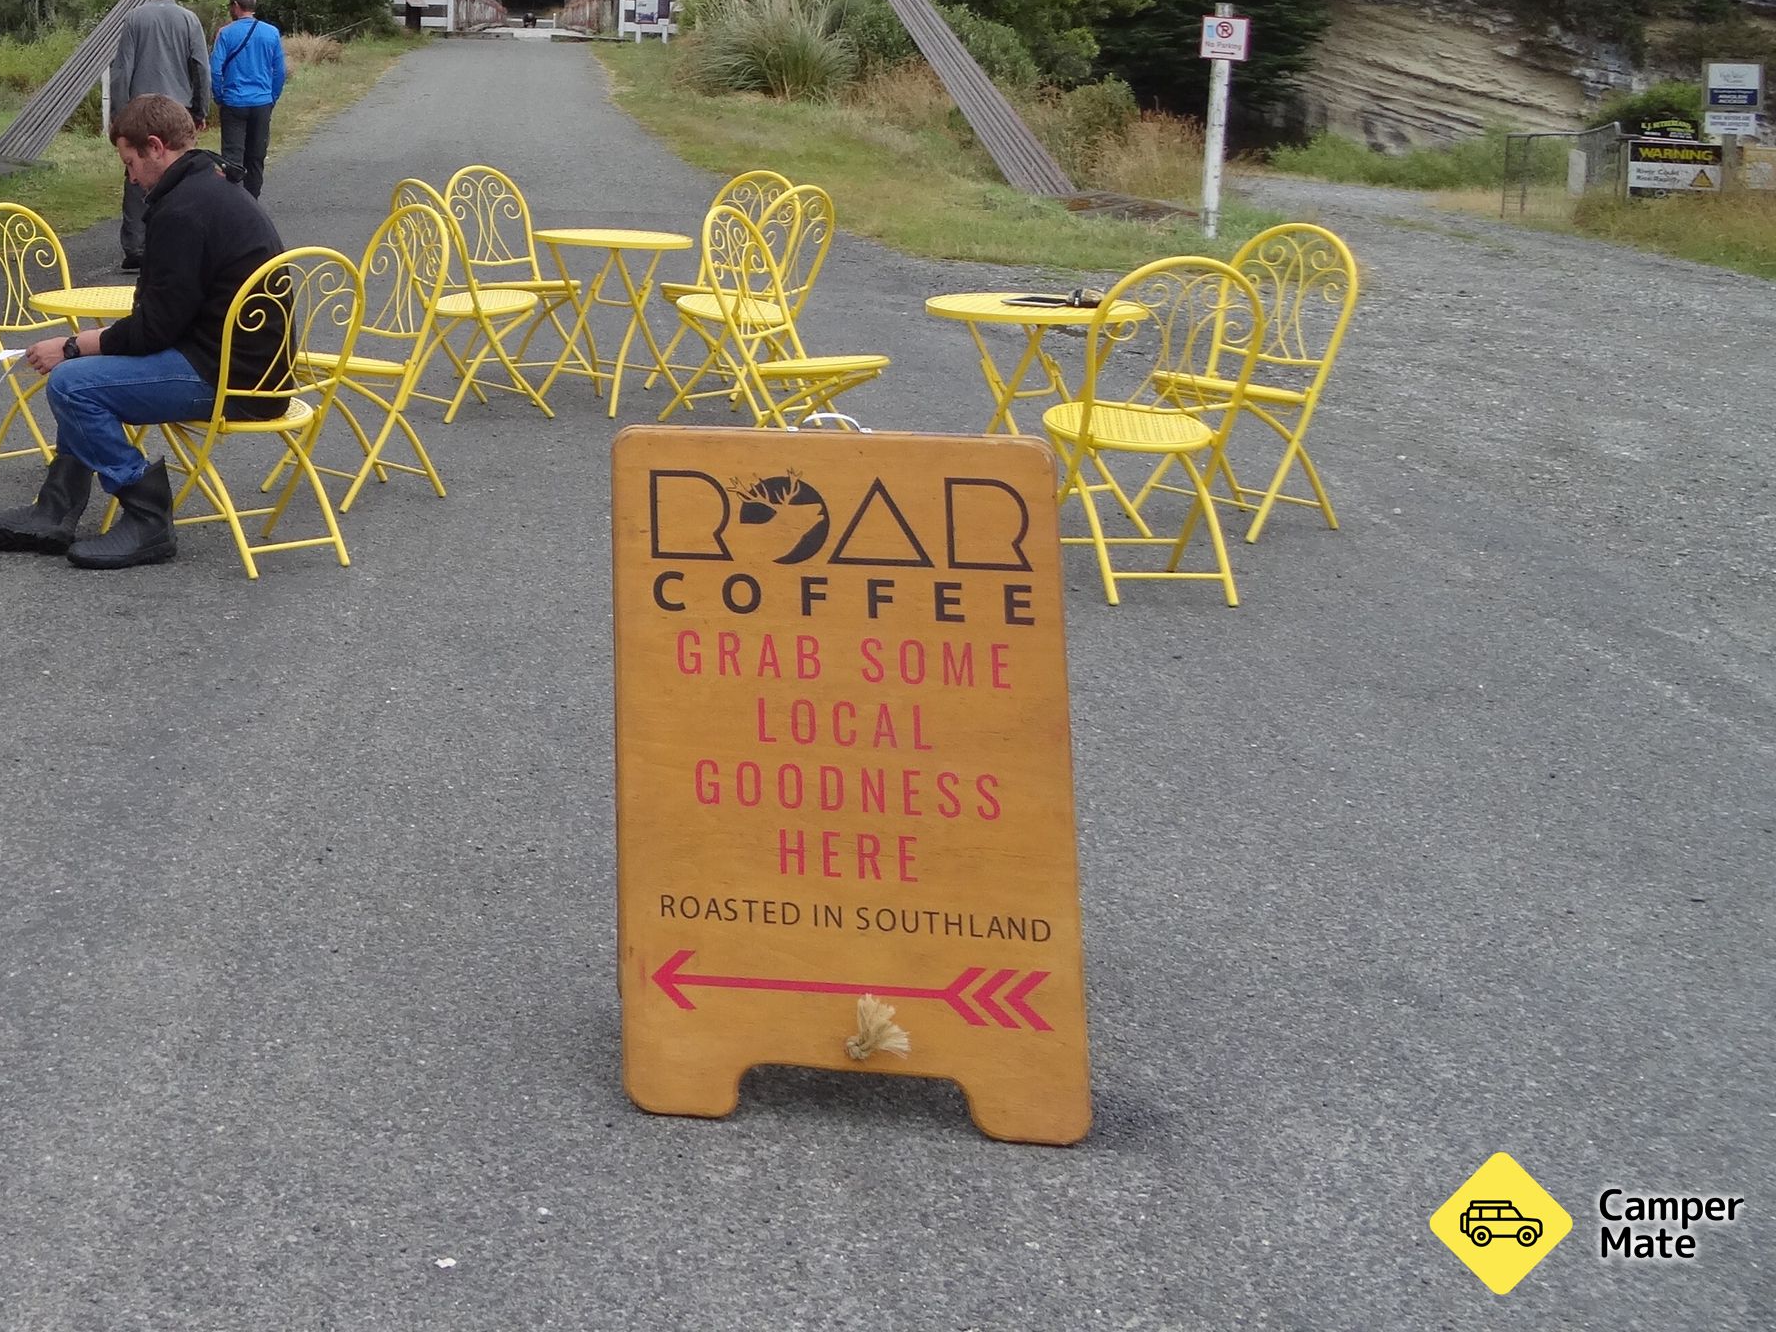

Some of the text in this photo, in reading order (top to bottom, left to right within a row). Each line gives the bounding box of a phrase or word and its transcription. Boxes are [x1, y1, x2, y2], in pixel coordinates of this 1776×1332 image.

[1639, 148, 1713, 161] WARNING
[649, 467, 1034, 573] ROAR
[652, 570, 1036, 627] COFFEE
[676, 629, 1012, 690] GRAB SOME
[757, 696, 933, 752] LOCAL
[694, 758, 1002, 821] GOODNESS
[778, 828, 920, 883] HERE
[660, 894, 1052, 944] ROASTED IN SOUTHLAND
